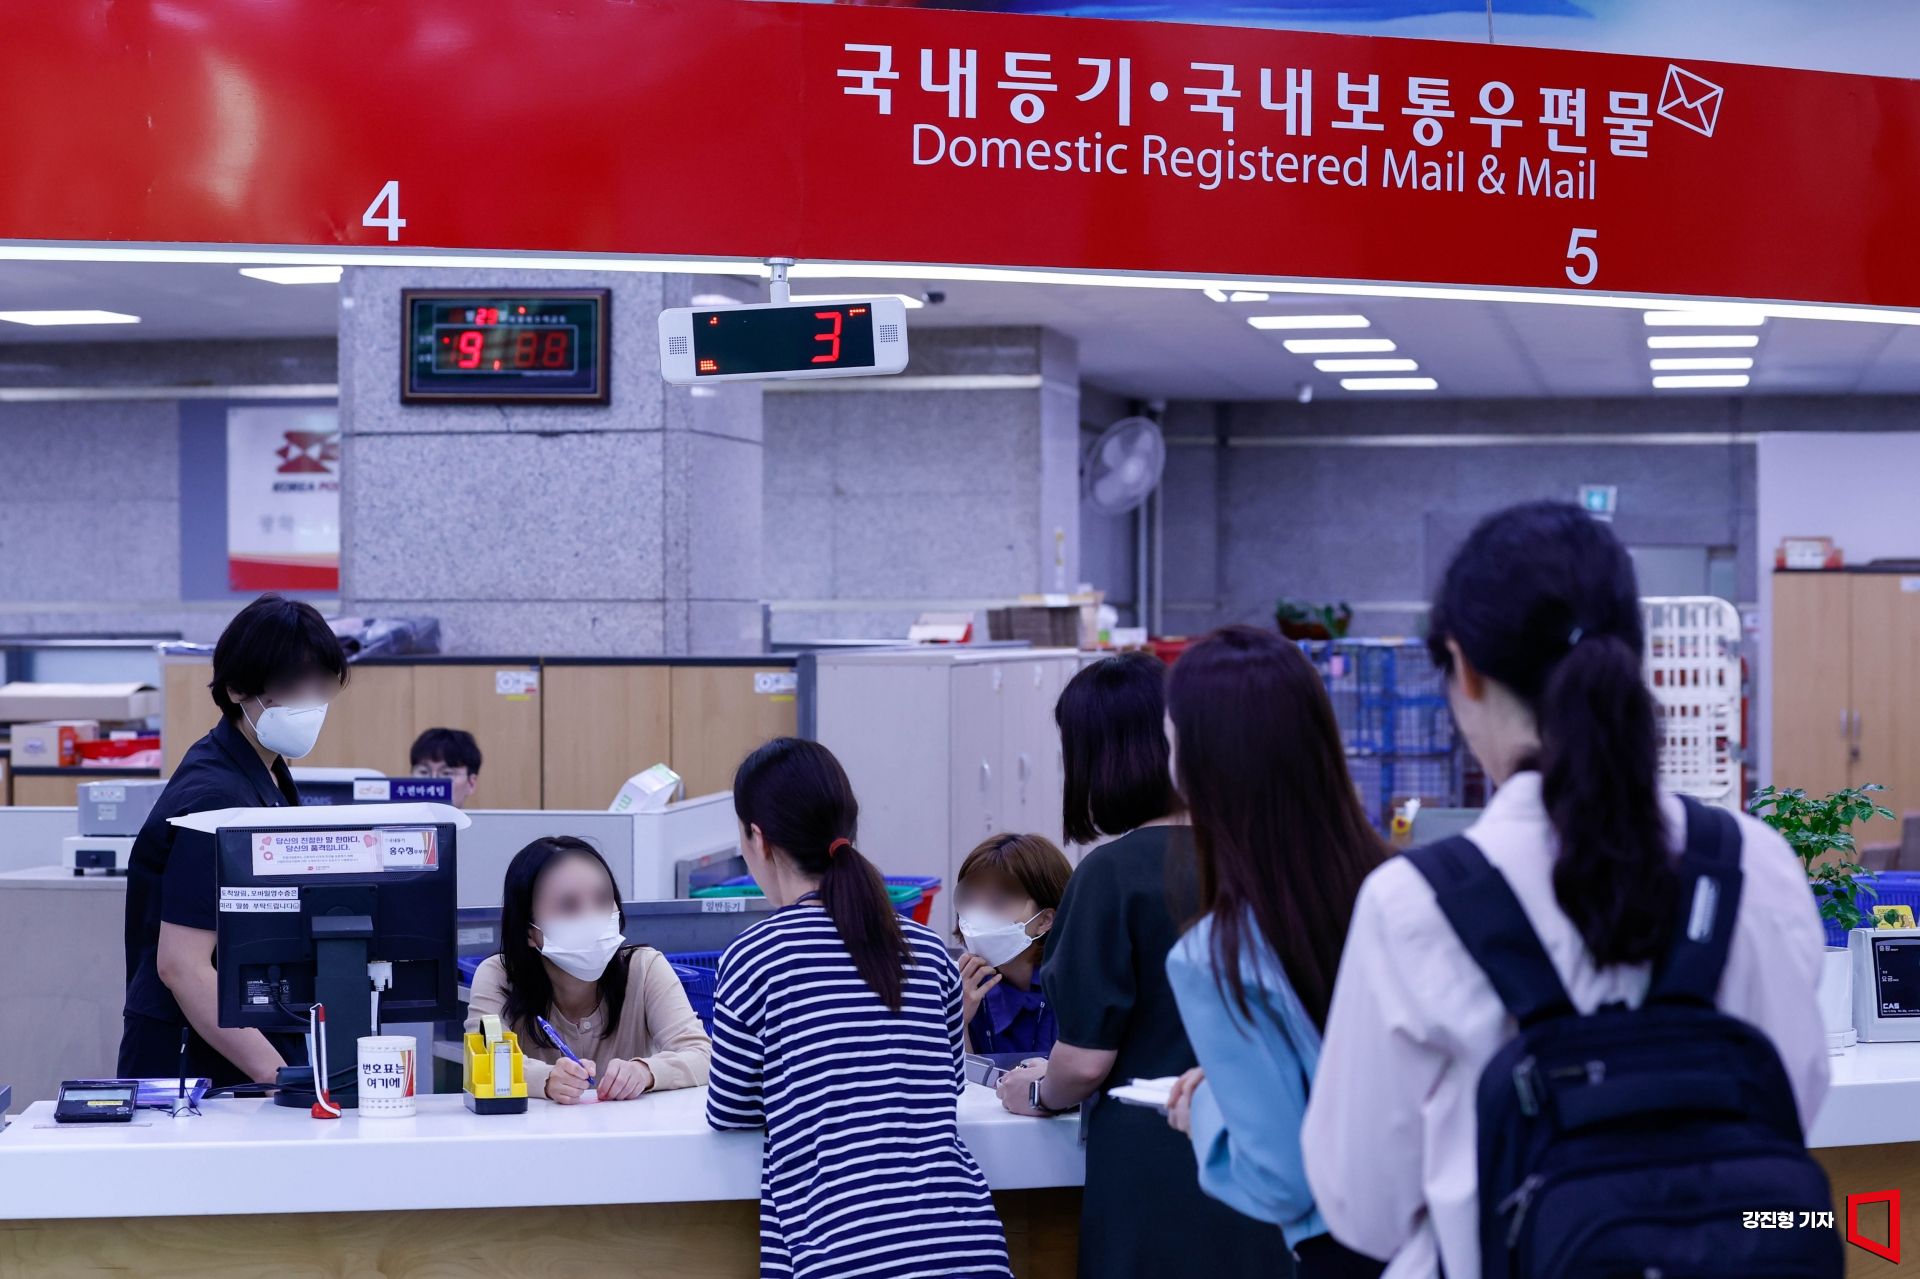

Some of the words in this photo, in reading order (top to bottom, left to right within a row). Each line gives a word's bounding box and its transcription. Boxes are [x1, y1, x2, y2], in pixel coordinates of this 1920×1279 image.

[913, 124, 1127, 174] Domestic
[1144, 135, 1366, 189] Registered
[1383, 149, 1464, 191] Mail
[1478, 155, 1506, 194] &
[1518, 157, 1595, 199] Mail
[362, 181, 406, 241] 4
[1566, 228, 1597, 285] 5
[811, 311, 842, 363] 3
[275, 837, 299, 845] 당신의
[301, 836, 323, 845] 친절한
[325, 836, 333, 844] 말
[362, 1063, 405, 1074] 번호표는
[367, 1077, 400, 1089] 여기에
